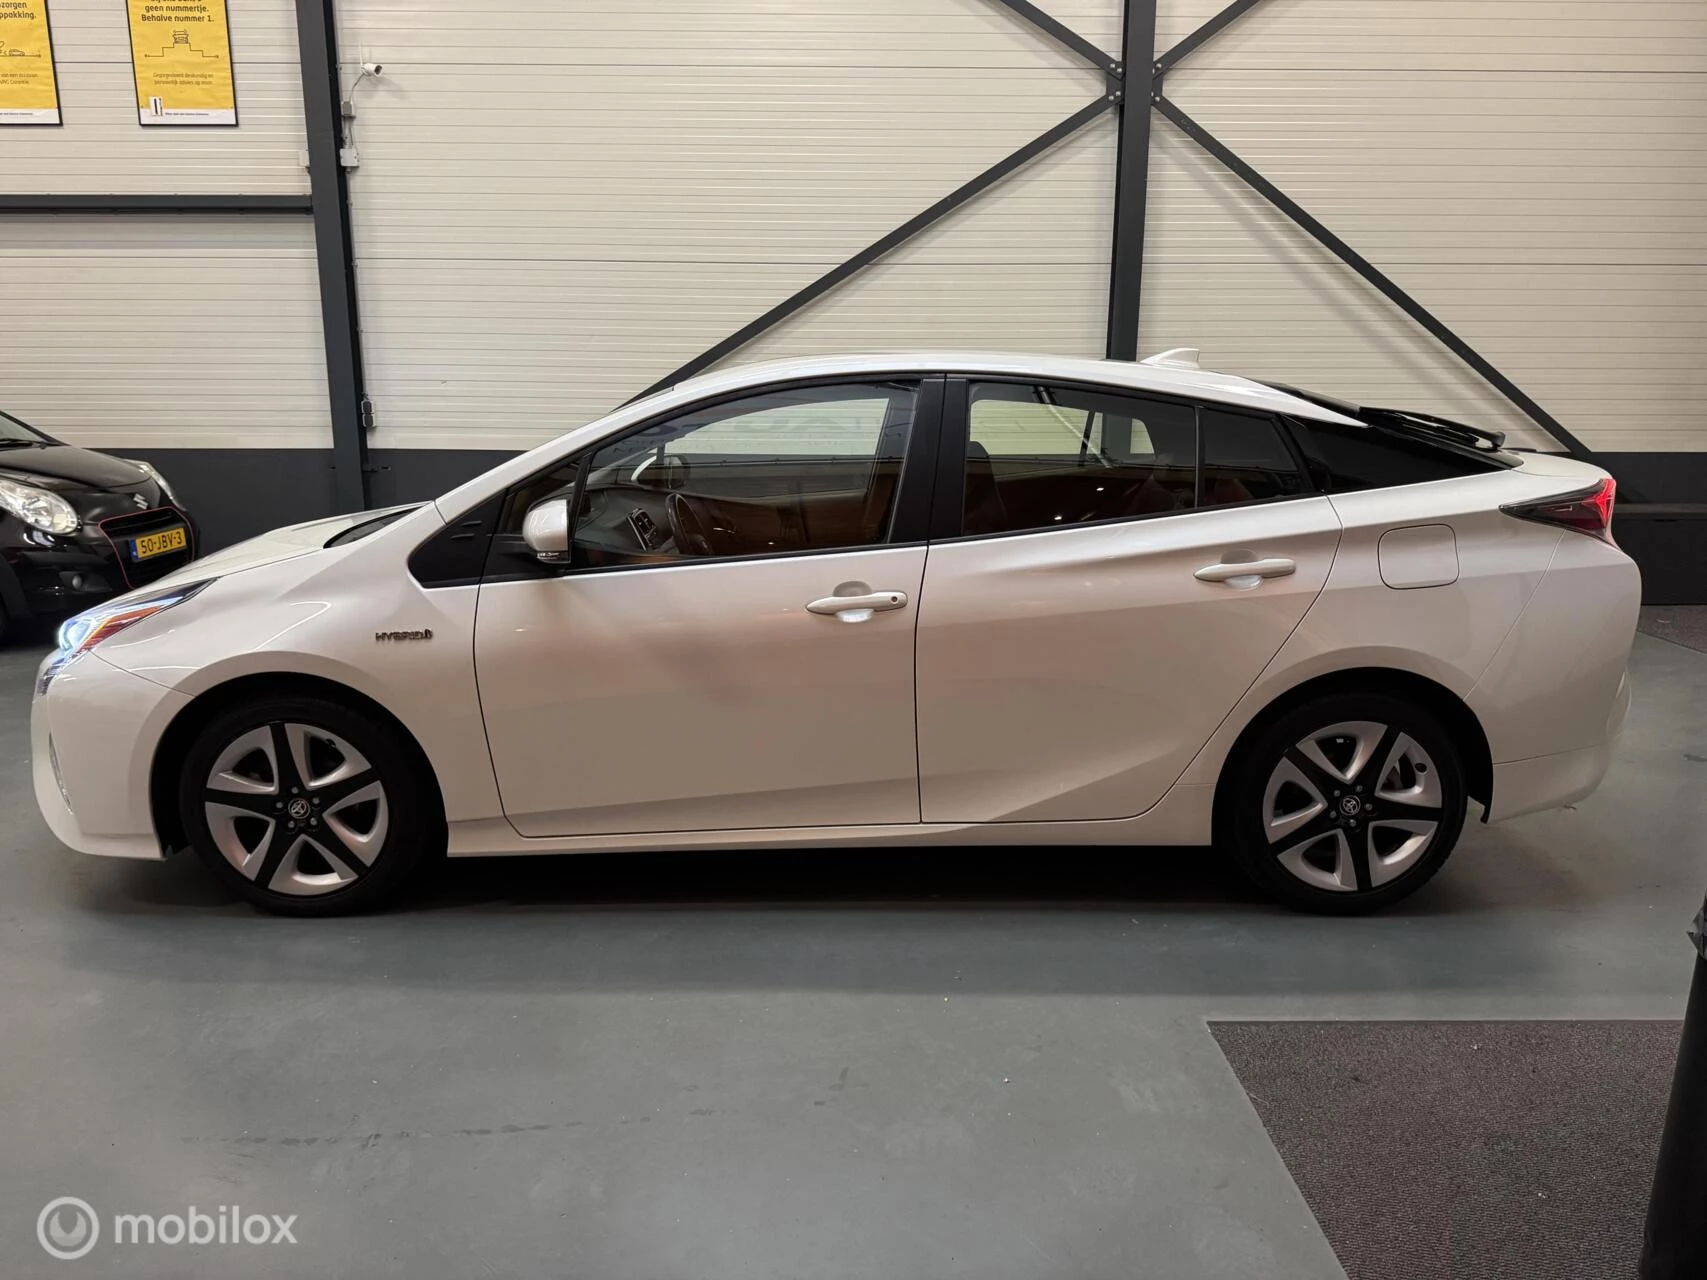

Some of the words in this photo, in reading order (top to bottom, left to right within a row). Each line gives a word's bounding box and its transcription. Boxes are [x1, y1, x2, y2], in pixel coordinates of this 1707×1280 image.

[0, 2, 27, 10] zorgen
[145, 5, 164, 13] geen
[166, 4, 209, 14] nummertje.
[141, 14, 173, 22] Behalve
[141, 531, 183, 554] 50-JBV-3
